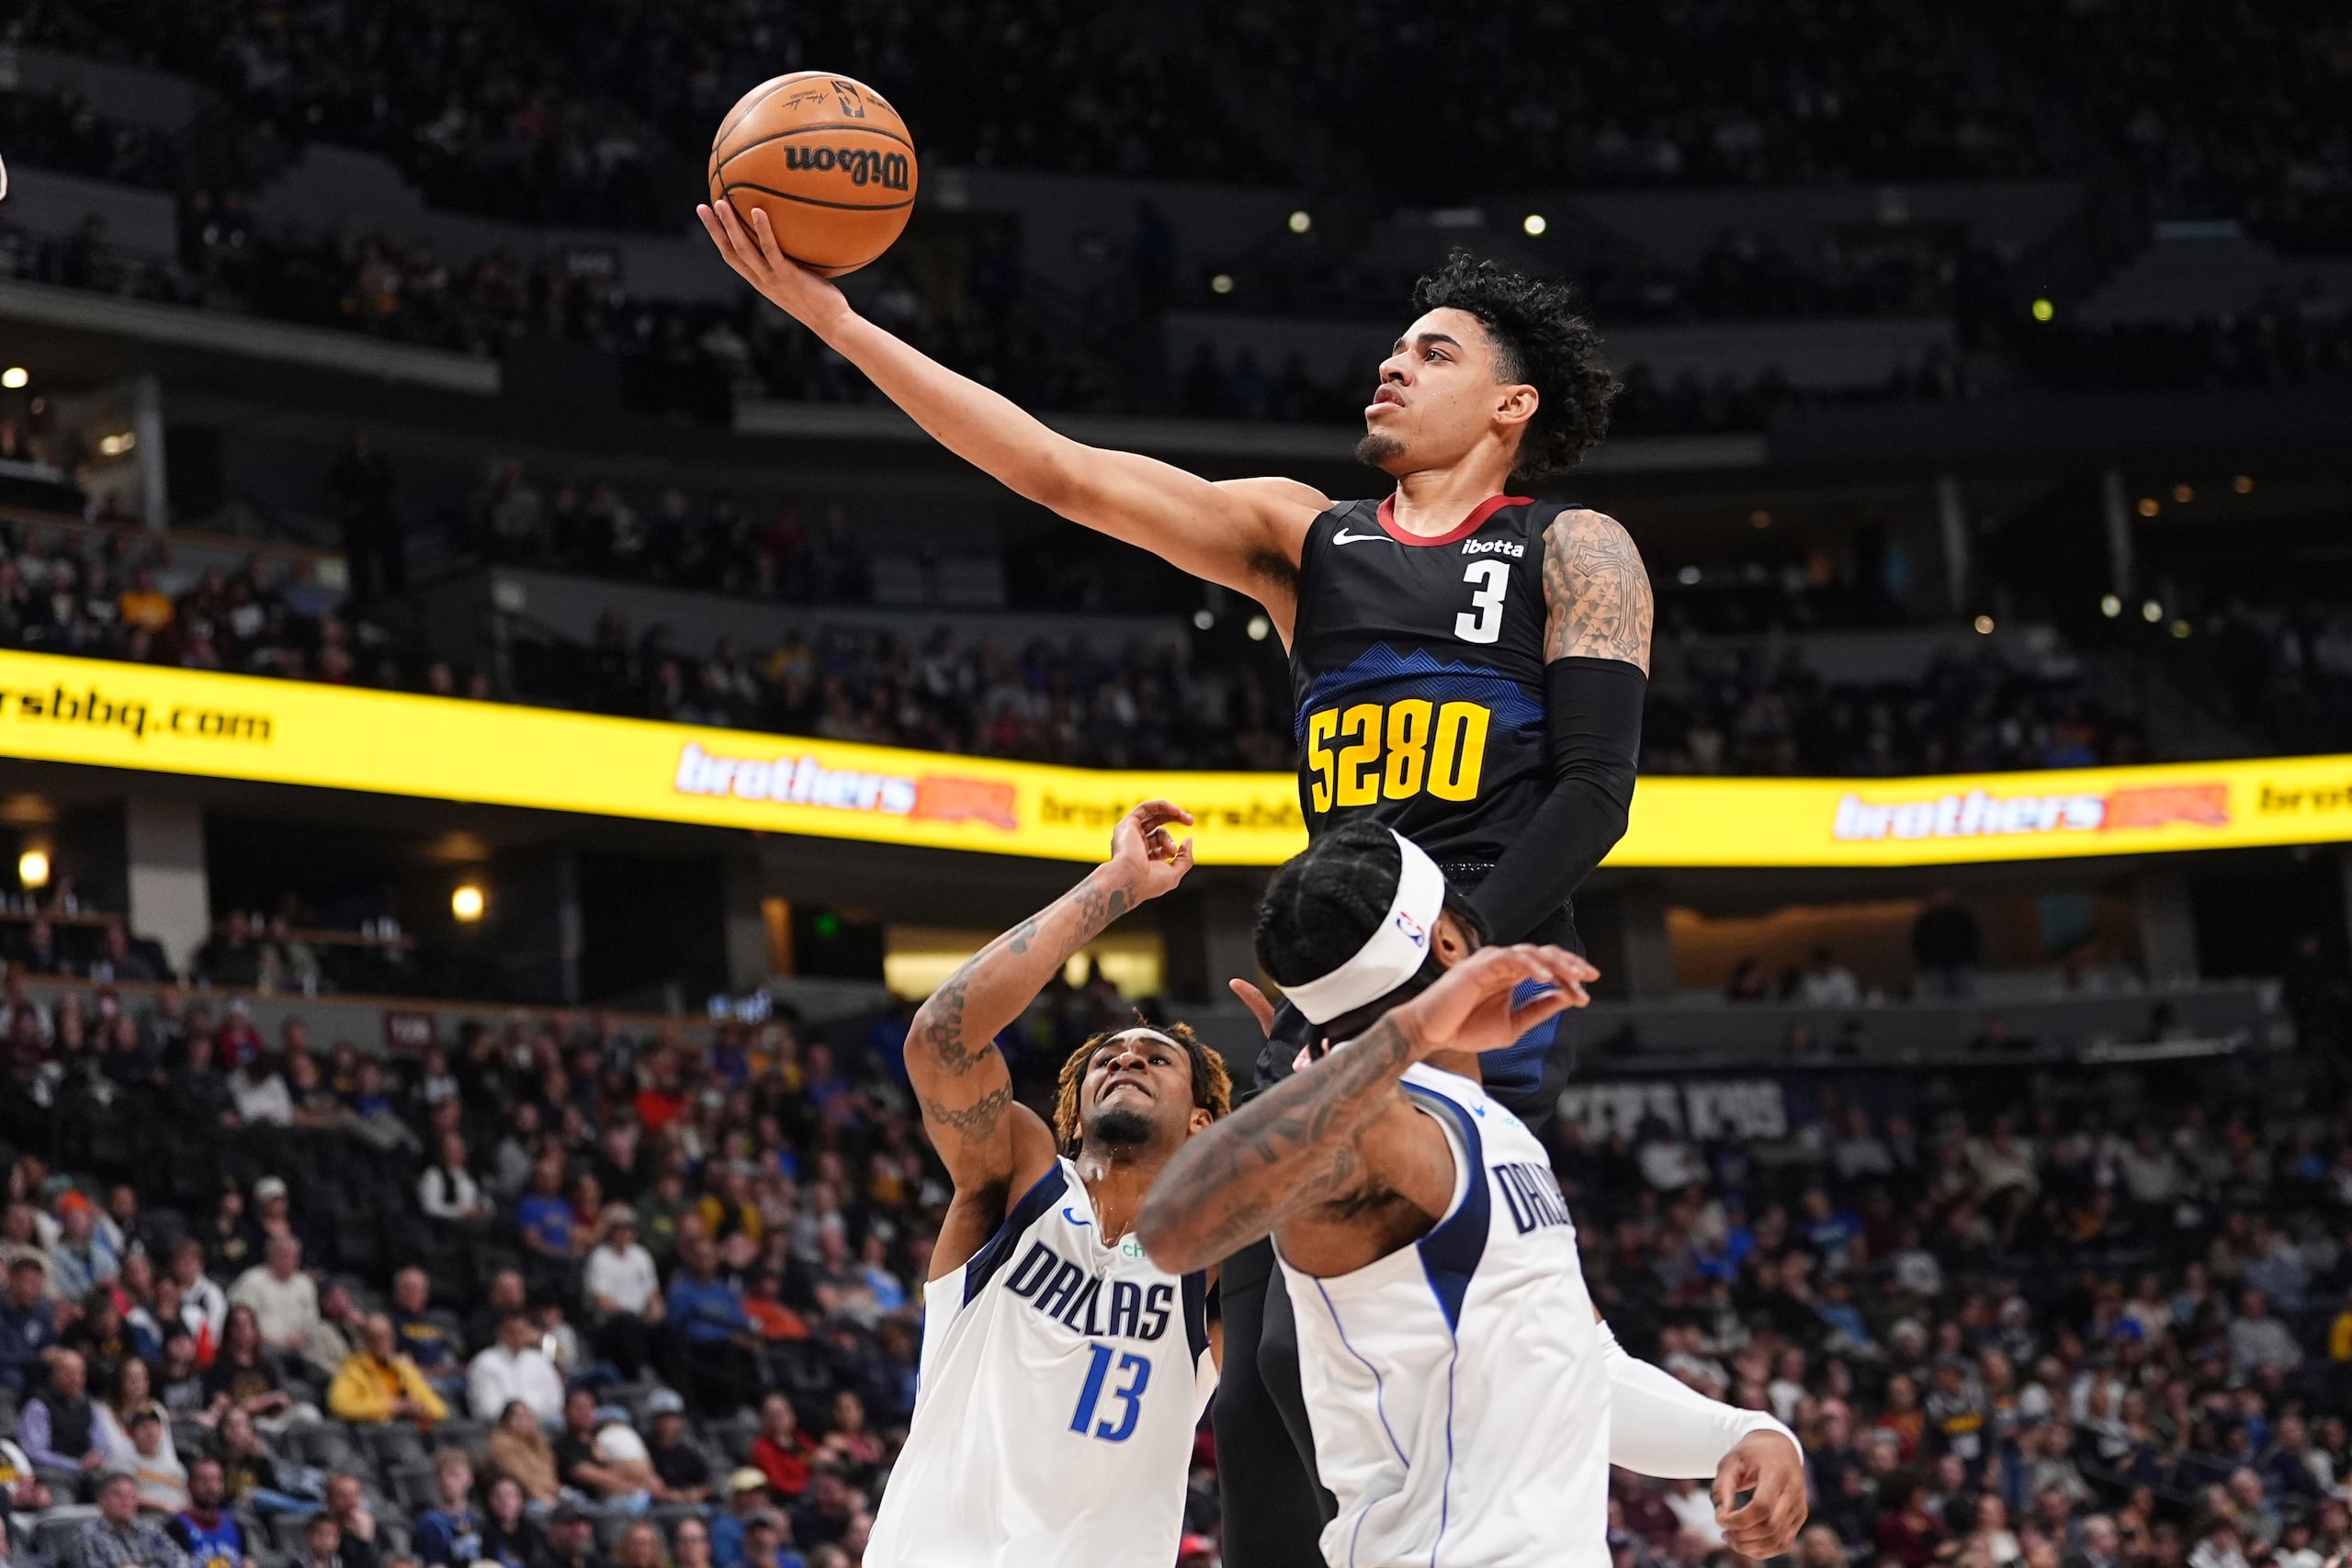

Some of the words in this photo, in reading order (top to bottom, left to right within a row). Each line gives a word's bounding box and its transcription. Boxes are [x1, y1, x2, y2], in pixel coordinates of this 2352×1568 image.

[784, 145, 909, 191] Wilson
[1461, 539, 1525, 558] ibotta
[1453, 558, 1510, 644] 3
[675, 742, 917, 816] brothers
[1307, 698, 1492, 814] 5280
[1832, 789, 2105, 841] brothers
[1002, 1239, 1177, 1342] DALLAS
[1068, 1340, 1152, 1445] 13
